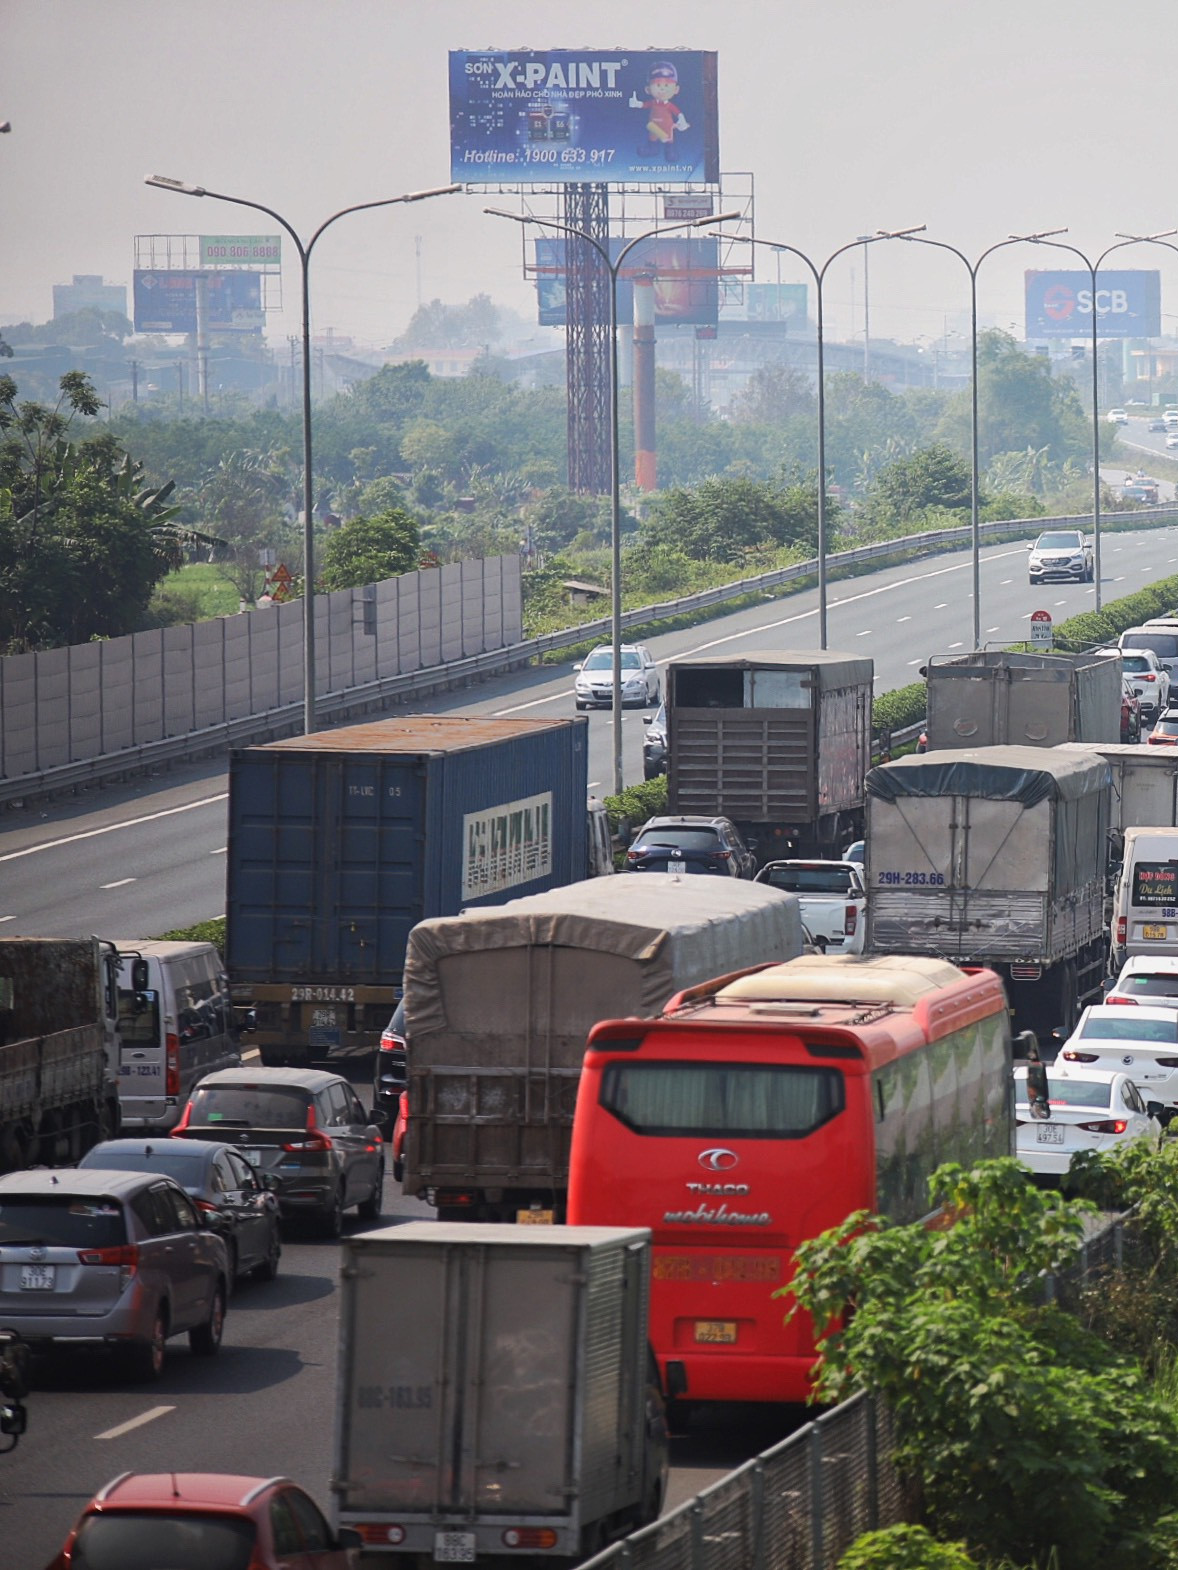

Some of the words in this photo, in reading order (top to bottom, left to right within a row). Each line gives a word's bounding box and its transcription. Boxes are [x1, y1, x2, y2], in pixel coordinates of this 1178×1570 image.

[465, 62, 492, 74] SƠN
[494, 62, 622, 89] X-PAINT
[464, 150, 519, 163] Hotline:
[525, 150, 556, 163] 1900
[561, 150, 586, 163] 633
[590, 149, 615, 163] 917
[629, 164, 692, 173] www.xpaint.vn
[1077, 289, 1128, 313] SCB
[878, 872, 945, 885] 29H-283.66
[1140, 883, 1153, 894] Du
[291, 987, 355, 1001] 29R-014.42
[686, 1182, 750, 1195] THACO
